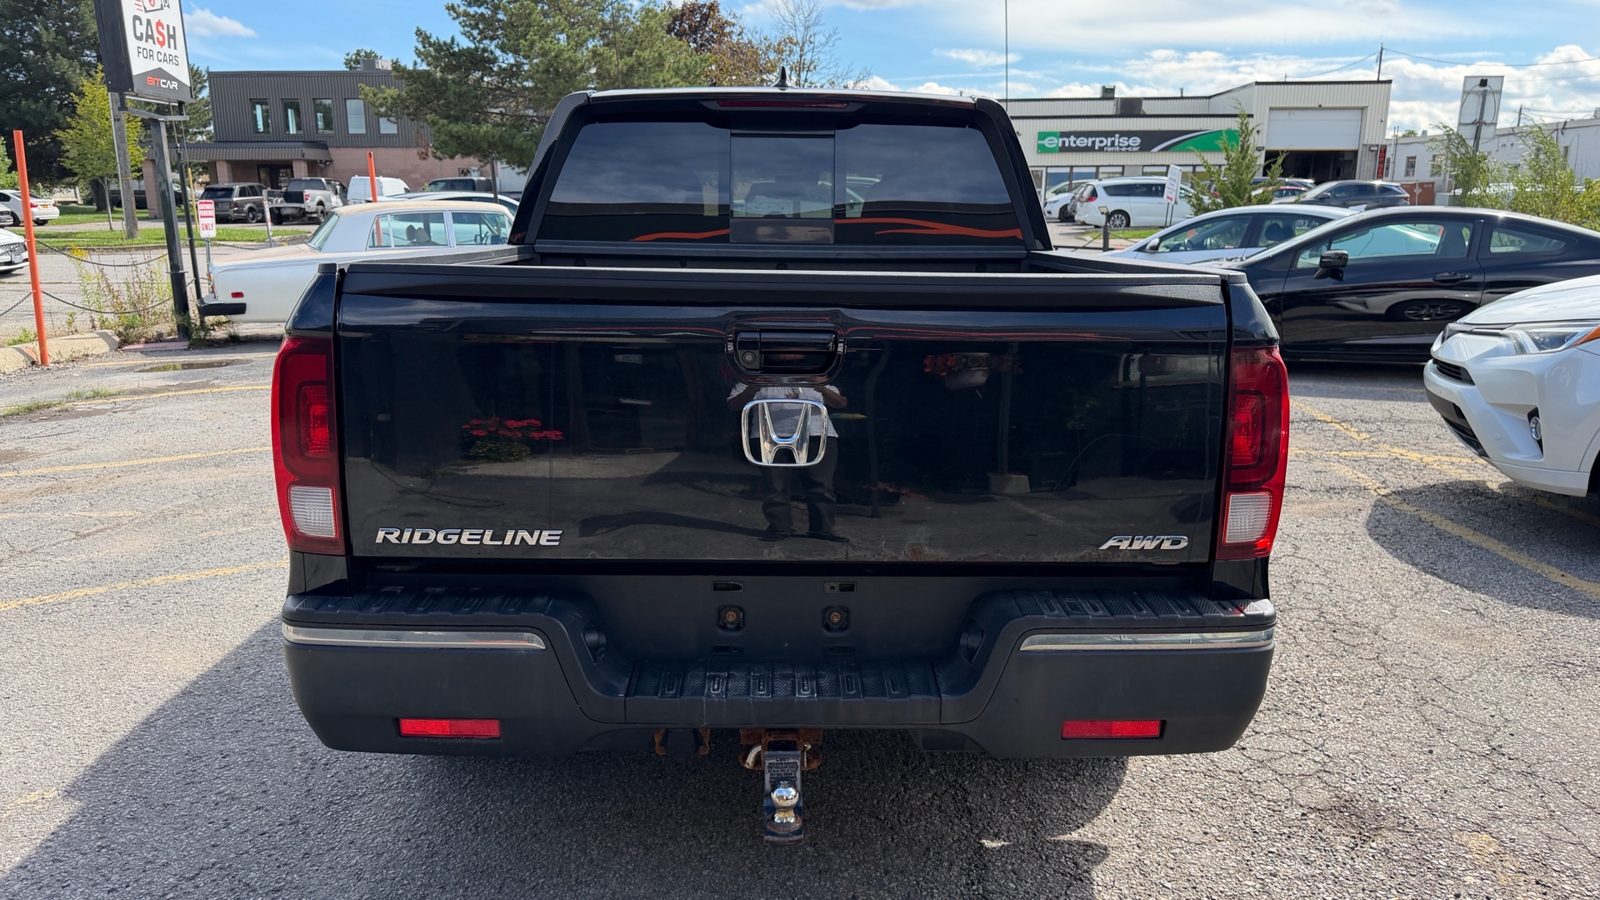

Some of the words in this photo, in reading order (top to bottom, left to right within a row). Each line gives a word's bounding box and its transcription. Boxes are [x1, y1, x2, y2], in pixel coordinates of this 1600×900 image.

[136, 46, 155, 61] FOR
[156, 51, 180, 66] CARS
[146, 75, 178, 90] BITCAR
[1037, 133, 1141, 150] enterprise
[375, 527, 563, 546] RIDGELINE
[1098, 535, 1189, 550] AWD
